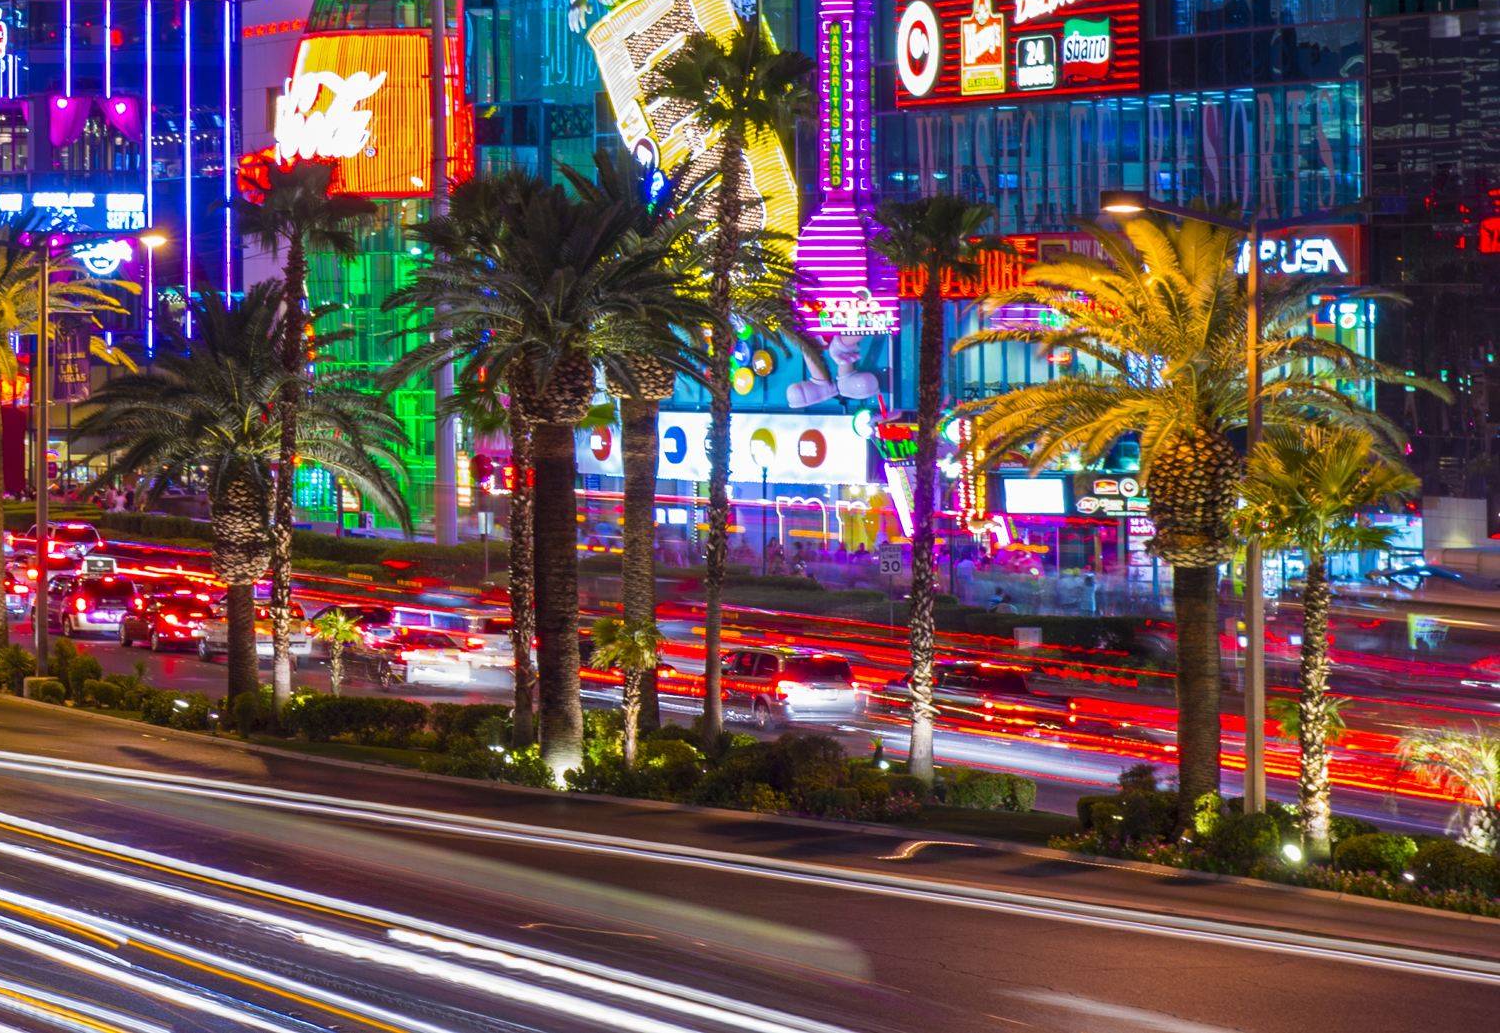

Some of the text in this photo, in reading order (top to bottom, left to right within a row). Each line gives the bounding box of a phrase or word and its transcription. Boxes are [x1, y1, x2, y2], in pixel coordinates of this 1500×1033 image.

[1025, 39, 1046, 66] 24
[1065, 35, 1108, 61] sbarro
[830, 24, 842, 128] MARGARITAS
[831, 143, 842, 186] YARD
[1281, 238, 1349, 274] USA
[881, 560, 901, 572] 30
